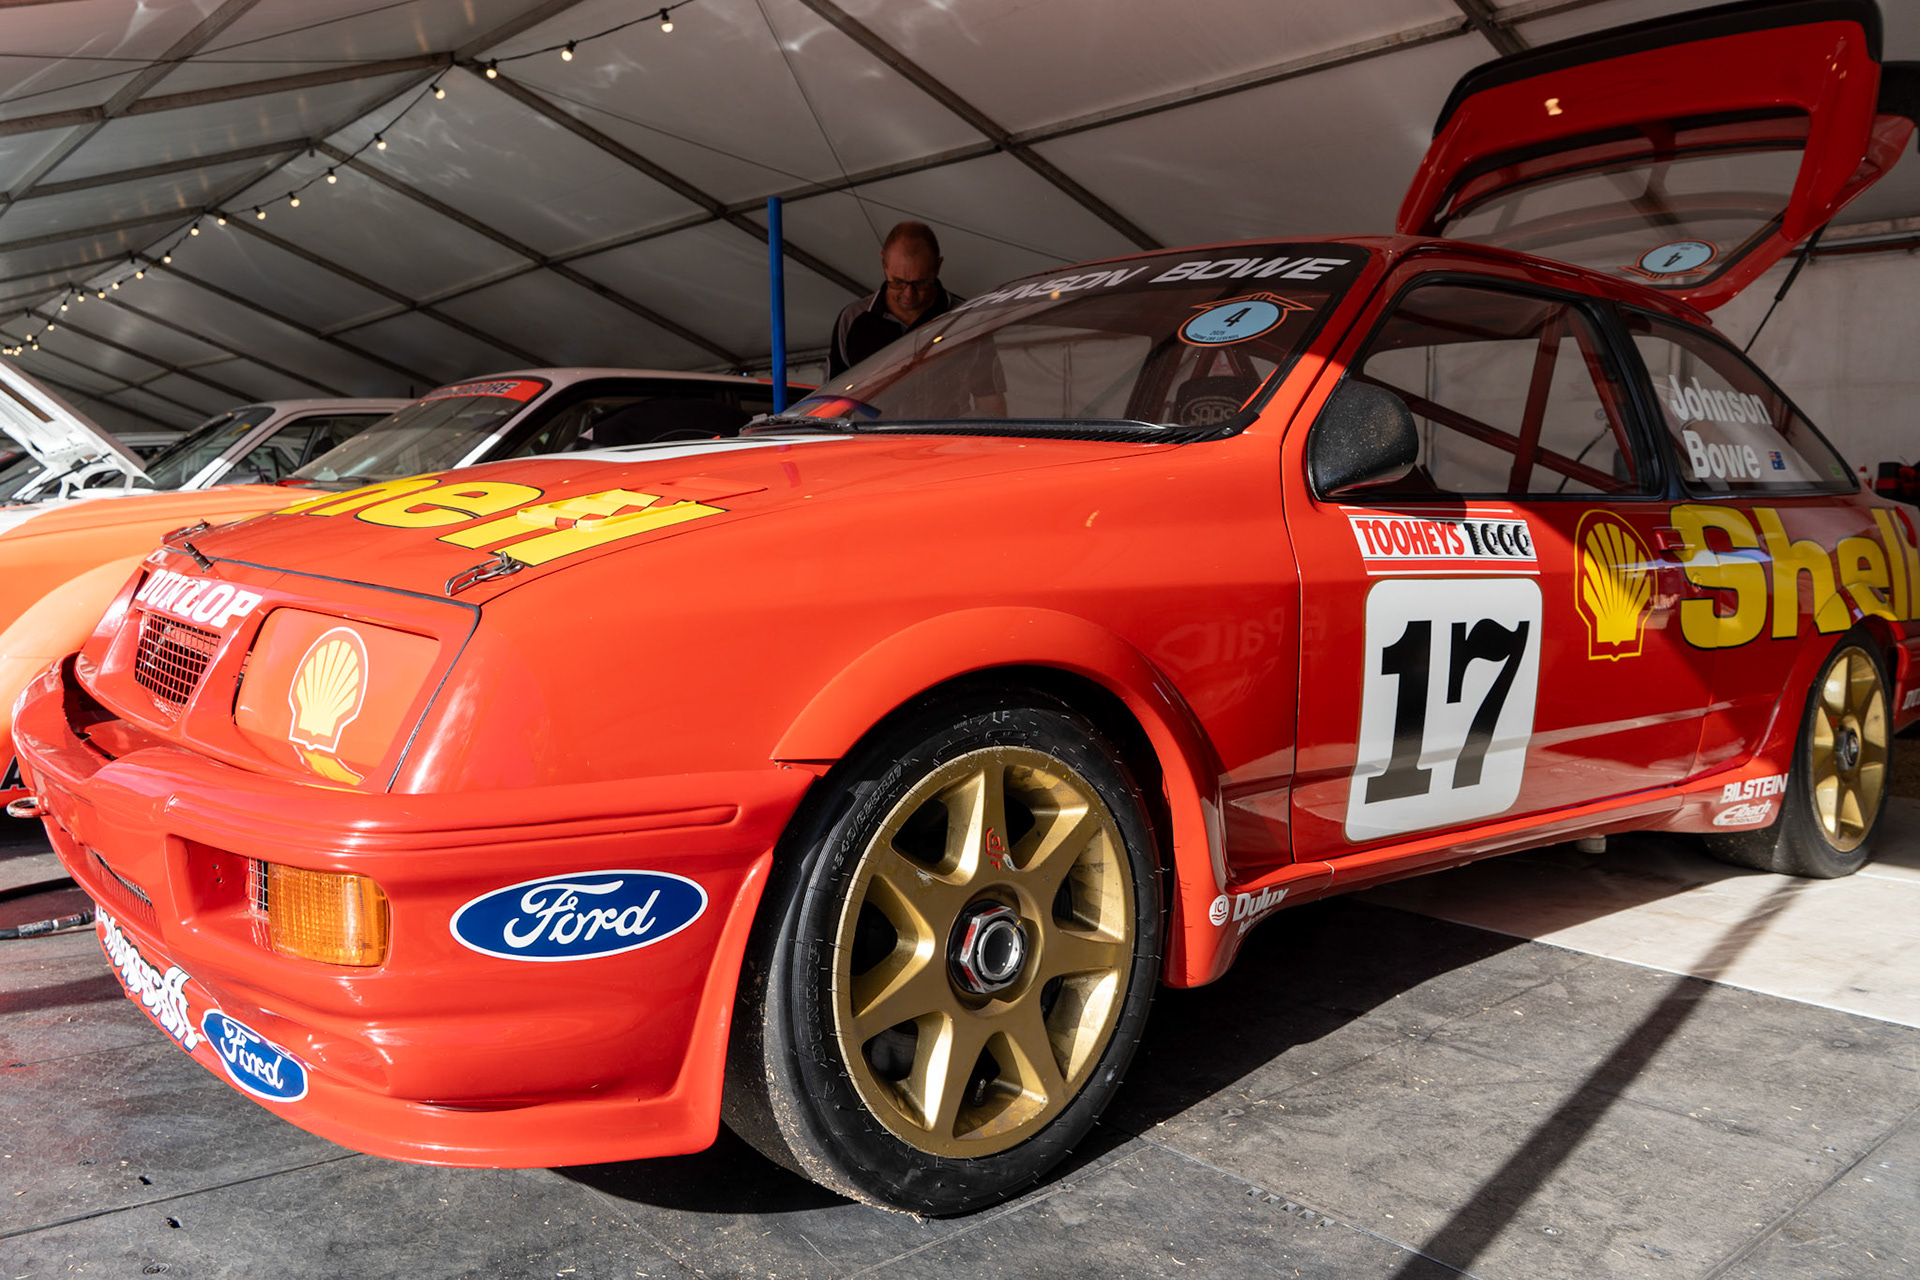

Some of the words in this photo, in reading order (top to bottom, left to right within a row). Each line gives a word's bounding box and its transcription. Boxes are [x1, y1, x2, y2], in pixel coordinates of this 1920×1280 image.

[950, 265, 1149, 315] OHNSON
[1149, 257, 1351, 284] BOWE
[1662, 252, 1683, 268] 4
[1223, 307, 1252, 327] 4
[1668, 374, 1773, 426] Johnson
[1682, 429, 1761, 479] Bowe
[1355, 519, 1465, 556] TOOHEYS
[1463, 522, 1536, 557] 1000
[134, 568, 263, 628] DUNLOP
[1668, 503, 1920, 650] Shell
[1364, 618, 1531, 805] 17
[1720, 773, 1789, 804] BILSTEIN
[503, 880, 661, 949] Ford
[1214, 900, 1226, 913] ICI
[220, 1018, 284, 1090] Ford
